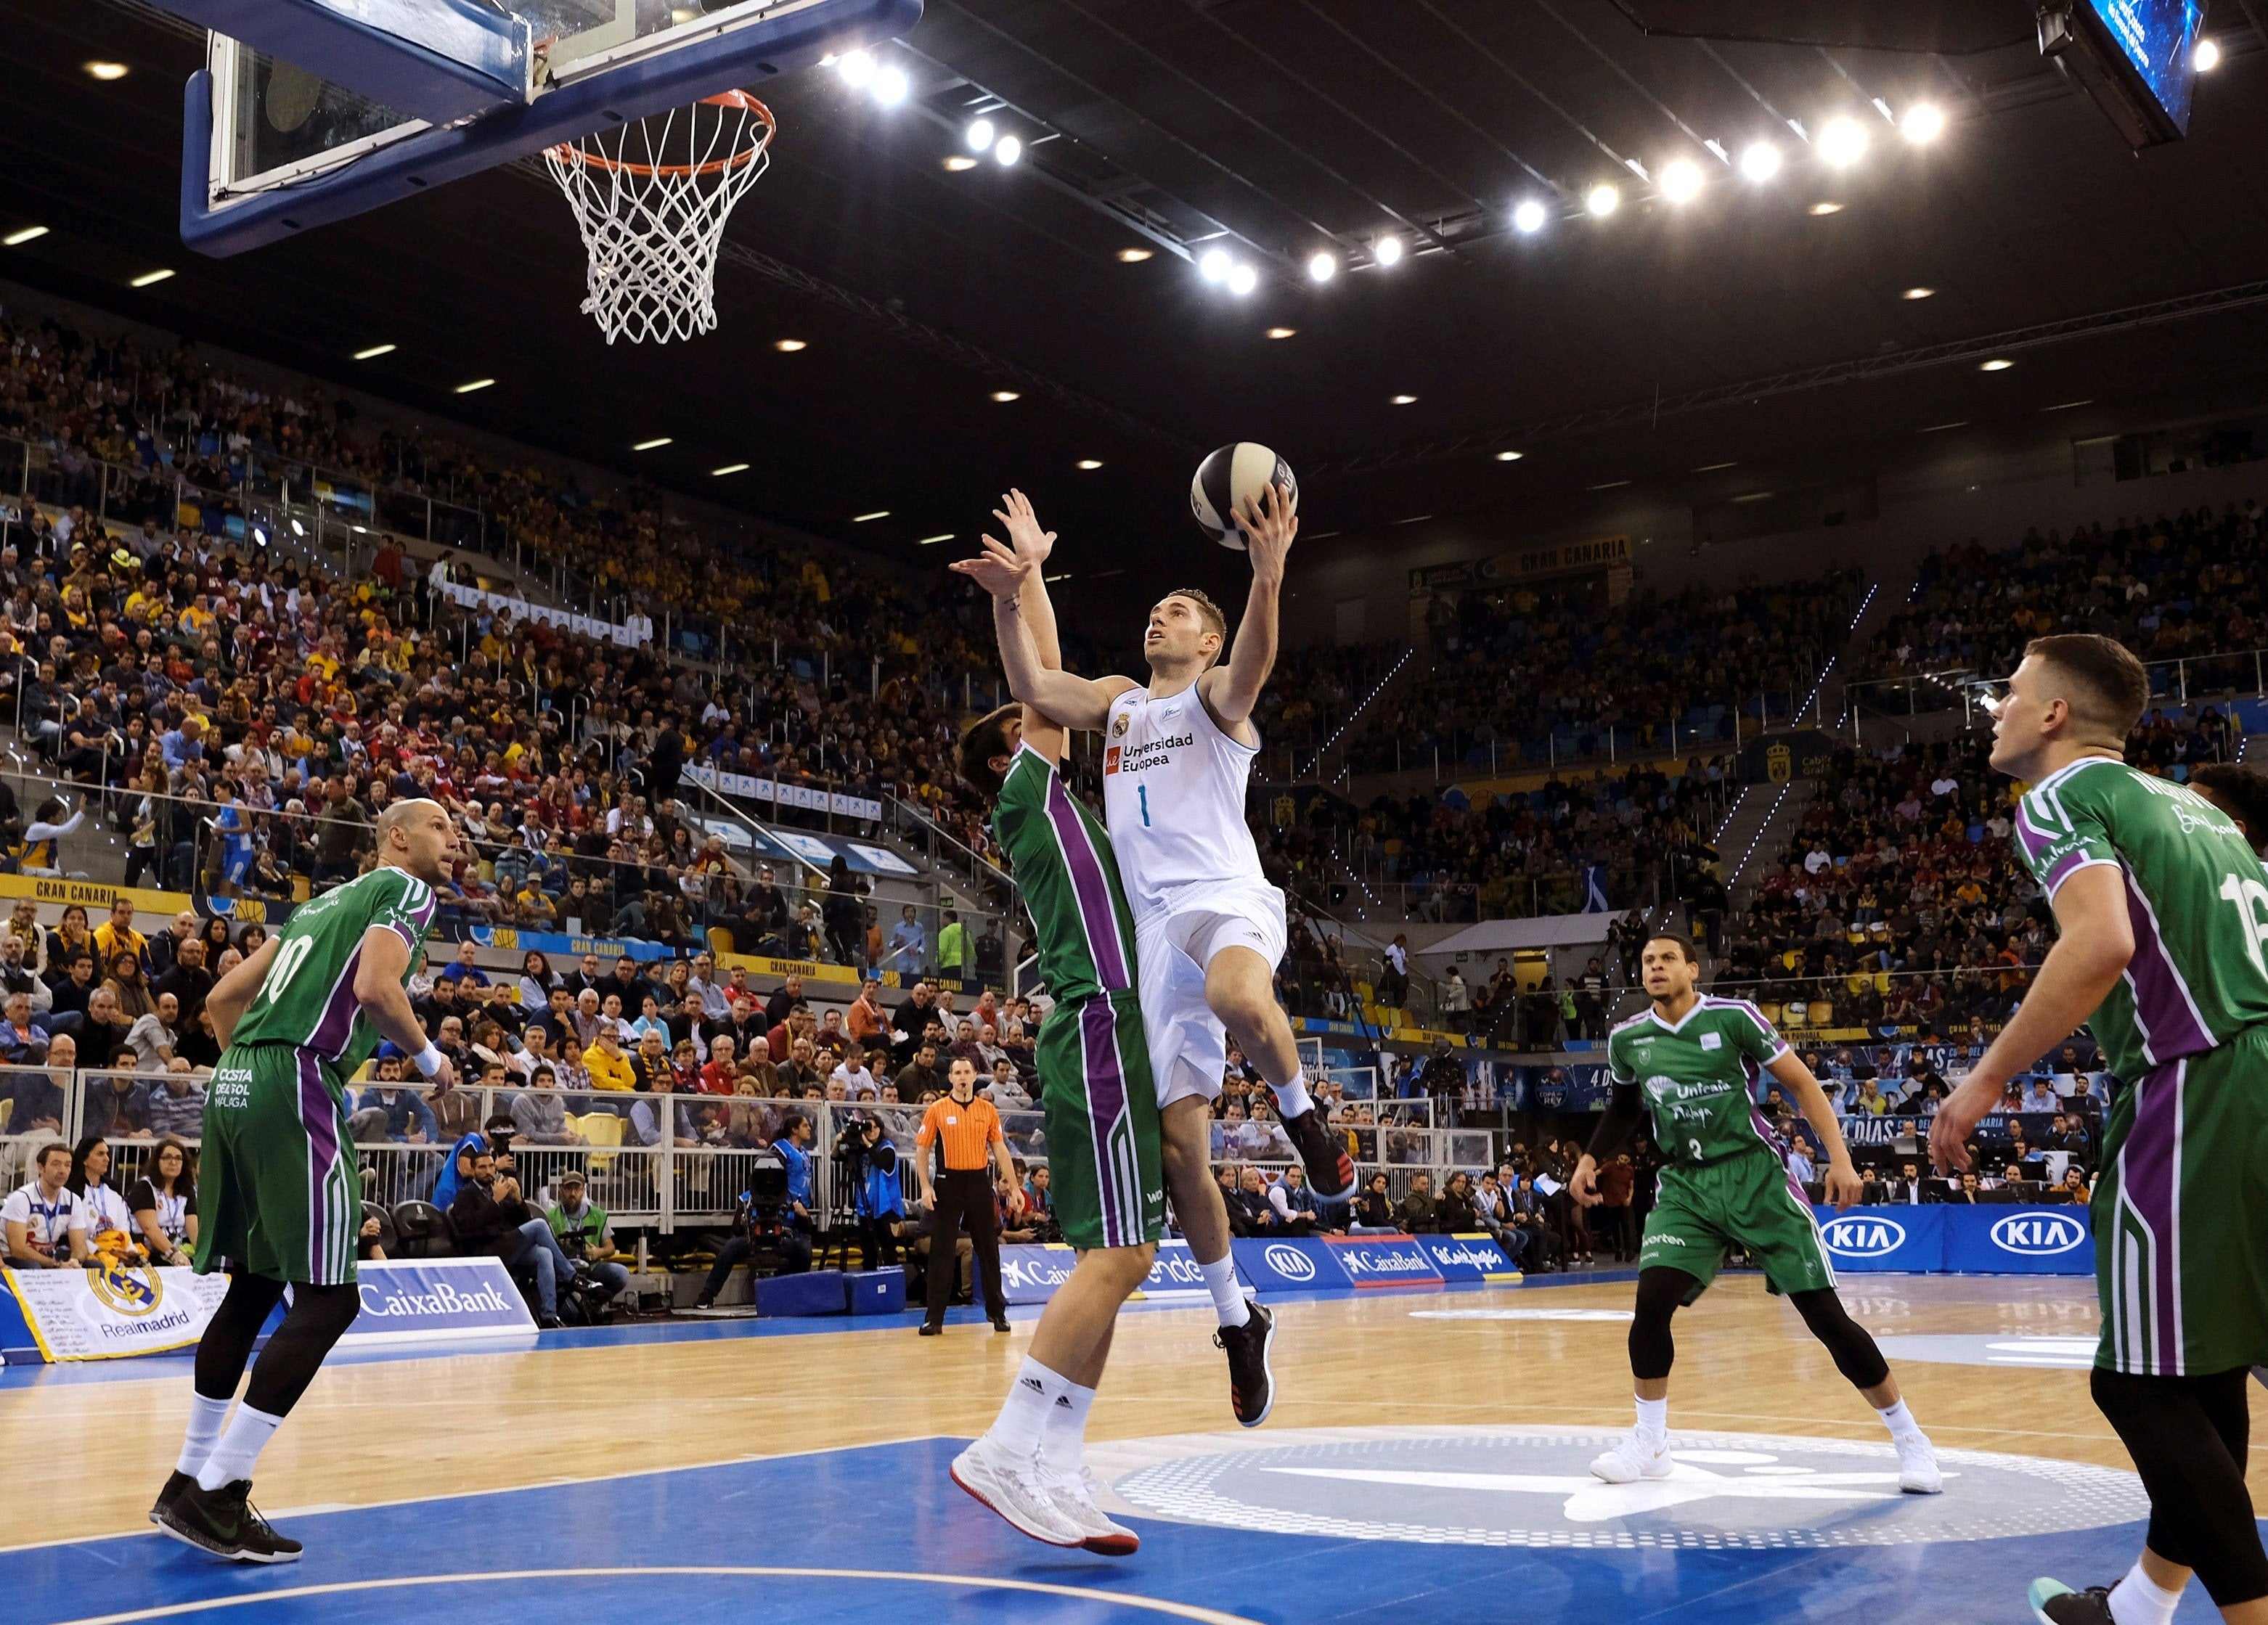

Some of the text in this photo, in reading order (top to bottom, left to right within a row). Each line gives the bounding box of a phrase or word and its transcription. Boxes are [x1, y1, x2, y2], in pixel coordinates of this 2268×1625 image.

[1521, 539, 1626, 571] GRAN CANARIA
[1124, 732, 1194, 758] Unversidad
[1122, 754, 1170, 772] Euopea
[1138, 784, 1151, 827] 1
[2035, 834, 2097, 885] ndalucía
[36, 881, 118, 904] GRAN CANARIA
[571, 939, 625, 956] GRAN CANARIA
[770, 960, 816, 976] GRAN CANARIA
[939, 979, 963, 991] CANARIA
[1949, 1024, 1968, 1035] GRAN
[1893, 1049, 1903, 1068] 4
[1969, 1047, 1981, 1057] DEL
[219, 1068, 253, 1082] COSTA
[1590, 1069, 1599, 1086] 4
[231, 1083, 250, 1095] SOL
[214, 1094, 248, 1108] MÁLAGA
[1854, 1116, 1895, 1142] DÍAS
[1832, 1224, 1890, 1248] KIA
[2007, 1221, 2069, 1246] KIA
[1270, 1252, 1311, 1273] KIA
[1361, 1249, 1429, 1272] CaixaBank
[358, 1281, 513, 1317] CaixaBank
[100, 1310, 190, 1338] Realmadrid
